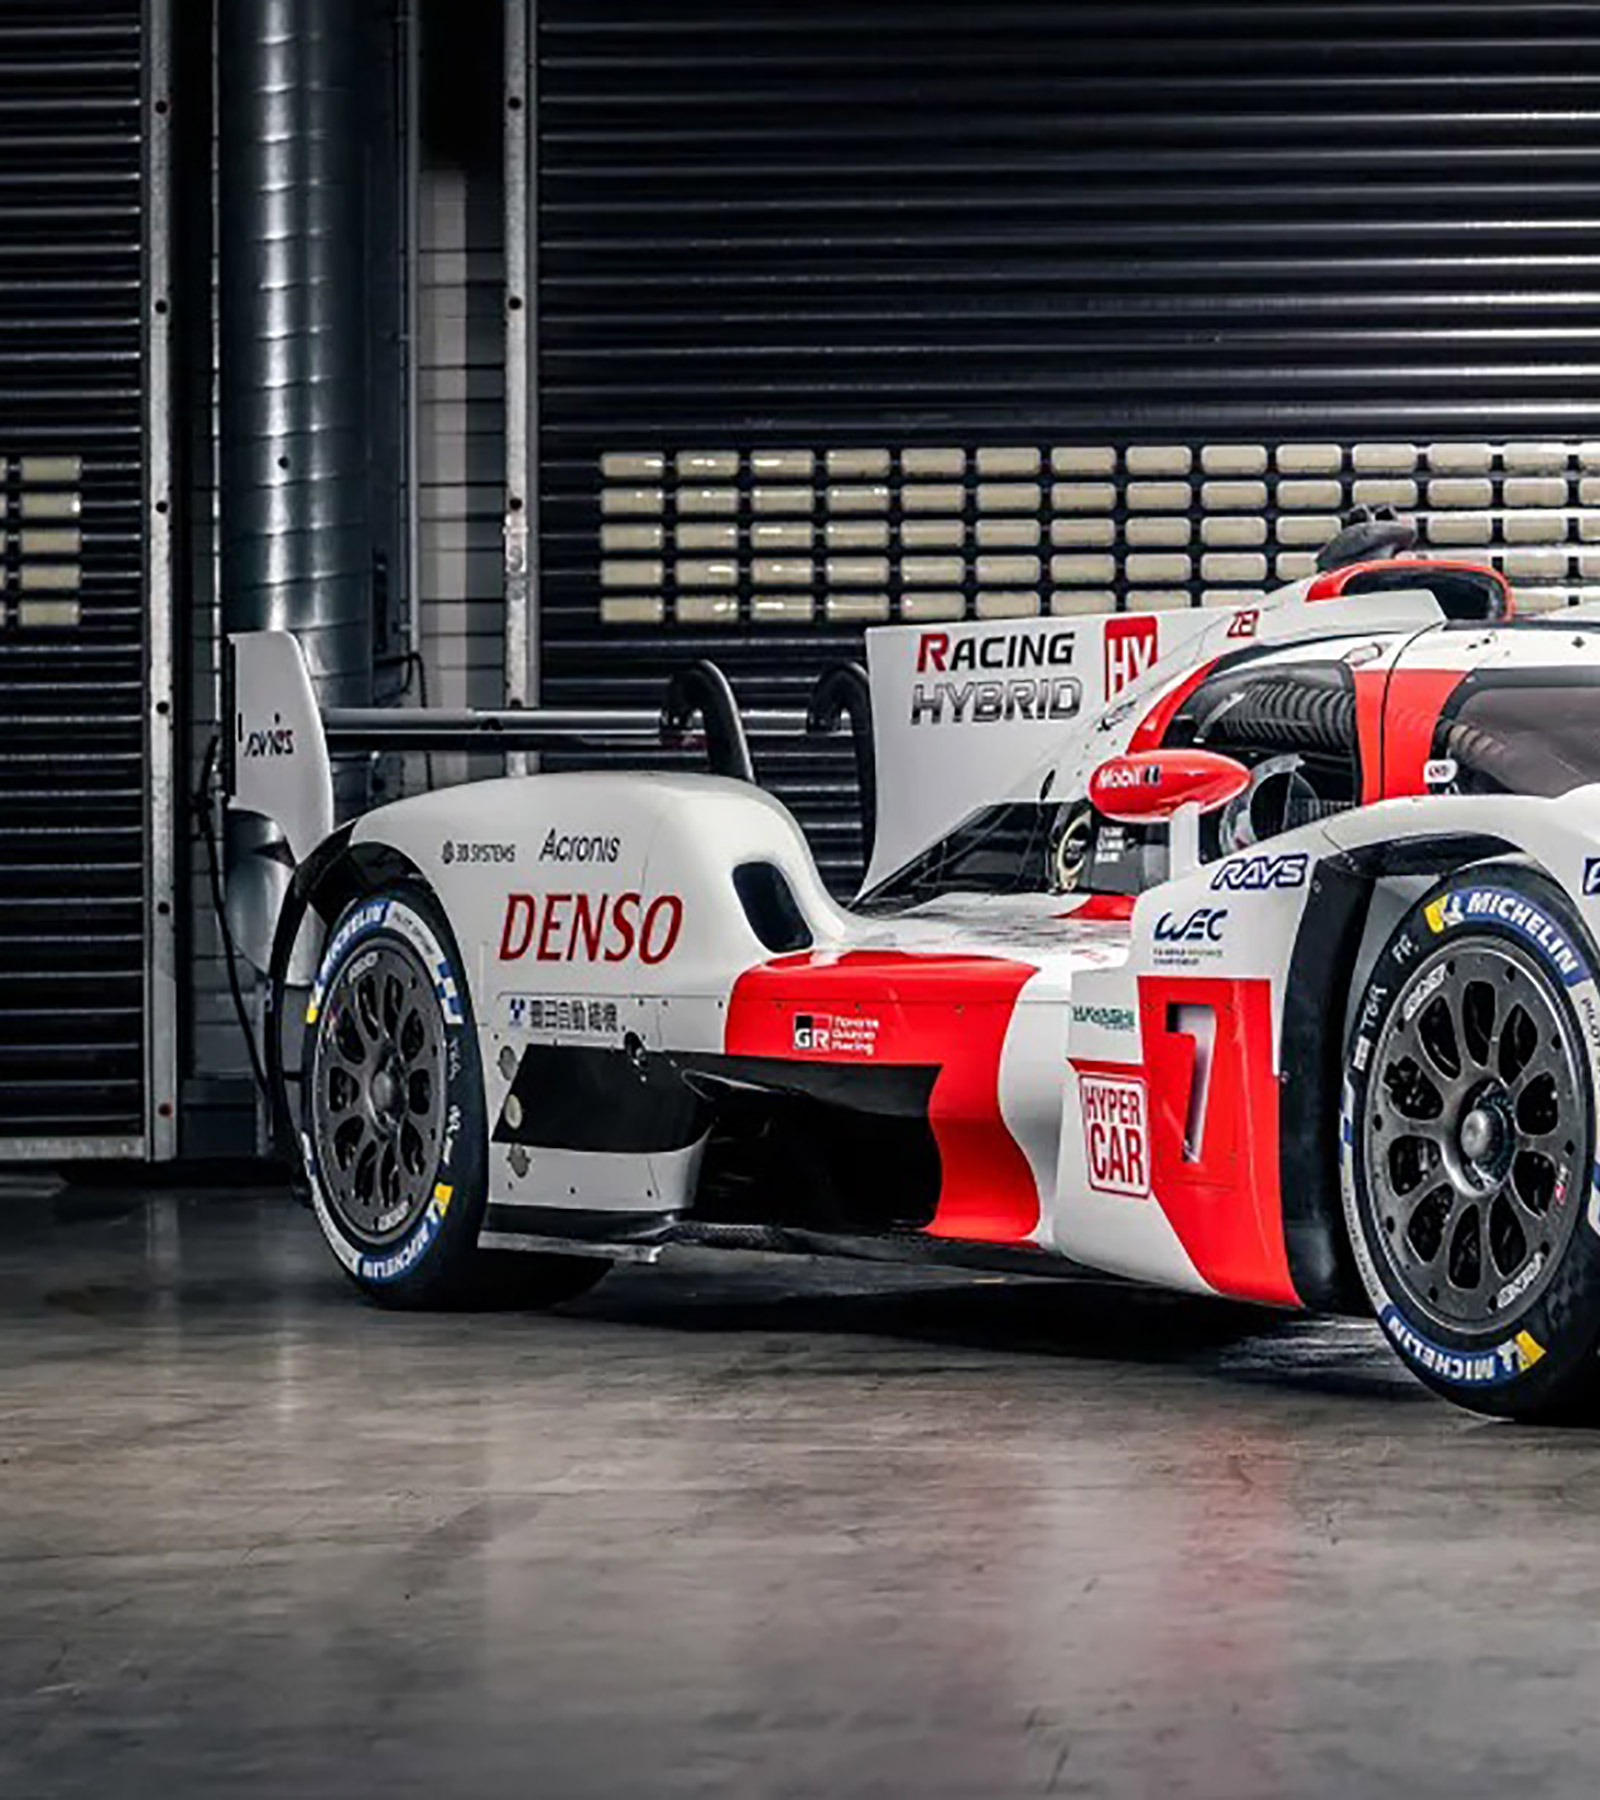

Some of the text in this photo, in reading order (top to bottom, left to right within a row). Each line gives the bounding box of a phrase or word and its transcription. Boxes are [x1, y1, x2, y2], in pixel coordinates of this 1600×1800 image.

[917, 632, 1075, 672] RACING
[910, 677, 1083, 725] HYBRID
[1098, 766, 1140, 789] Mobil
[538, 828, 621, 863] Acronis
[1210, 853, 1309, 890] RAYS
[499, 892, 683, 965] DENSO
[1153, 909, 1228, 941] WEC
[1467, 892, 1580, 975] MICHELIN
[795, 1028, 830, 1050] GR
[1165, 1002, 1216, 1164] 7
[1084, 1085, 1141, 1126] HYPER
[1089, 1123, 1144, 1186] CAR
[1387, 1315, 1496, 1380] MICHELIN
